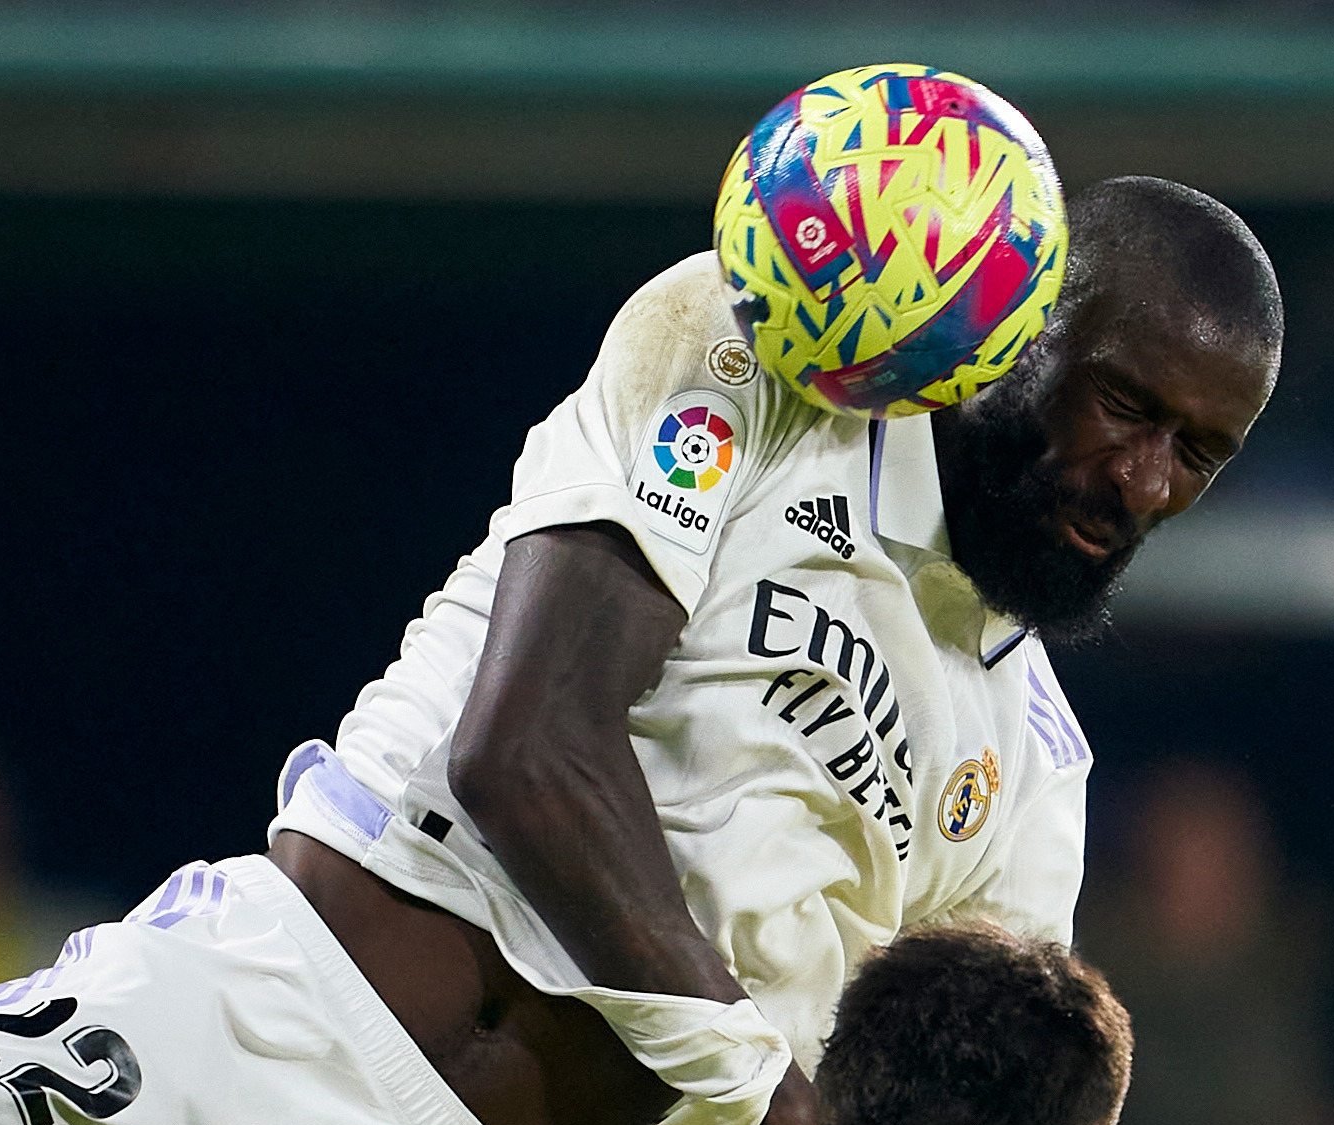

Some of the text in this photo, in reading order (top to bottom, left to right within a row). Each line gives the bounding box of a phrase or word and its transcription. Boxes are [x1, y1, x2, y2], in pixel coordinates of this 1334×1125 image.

[635, 481, 710, 533] LaLiga
[784, 504, 856, 561] adidas
[761, 668, 856, 738] FLY
